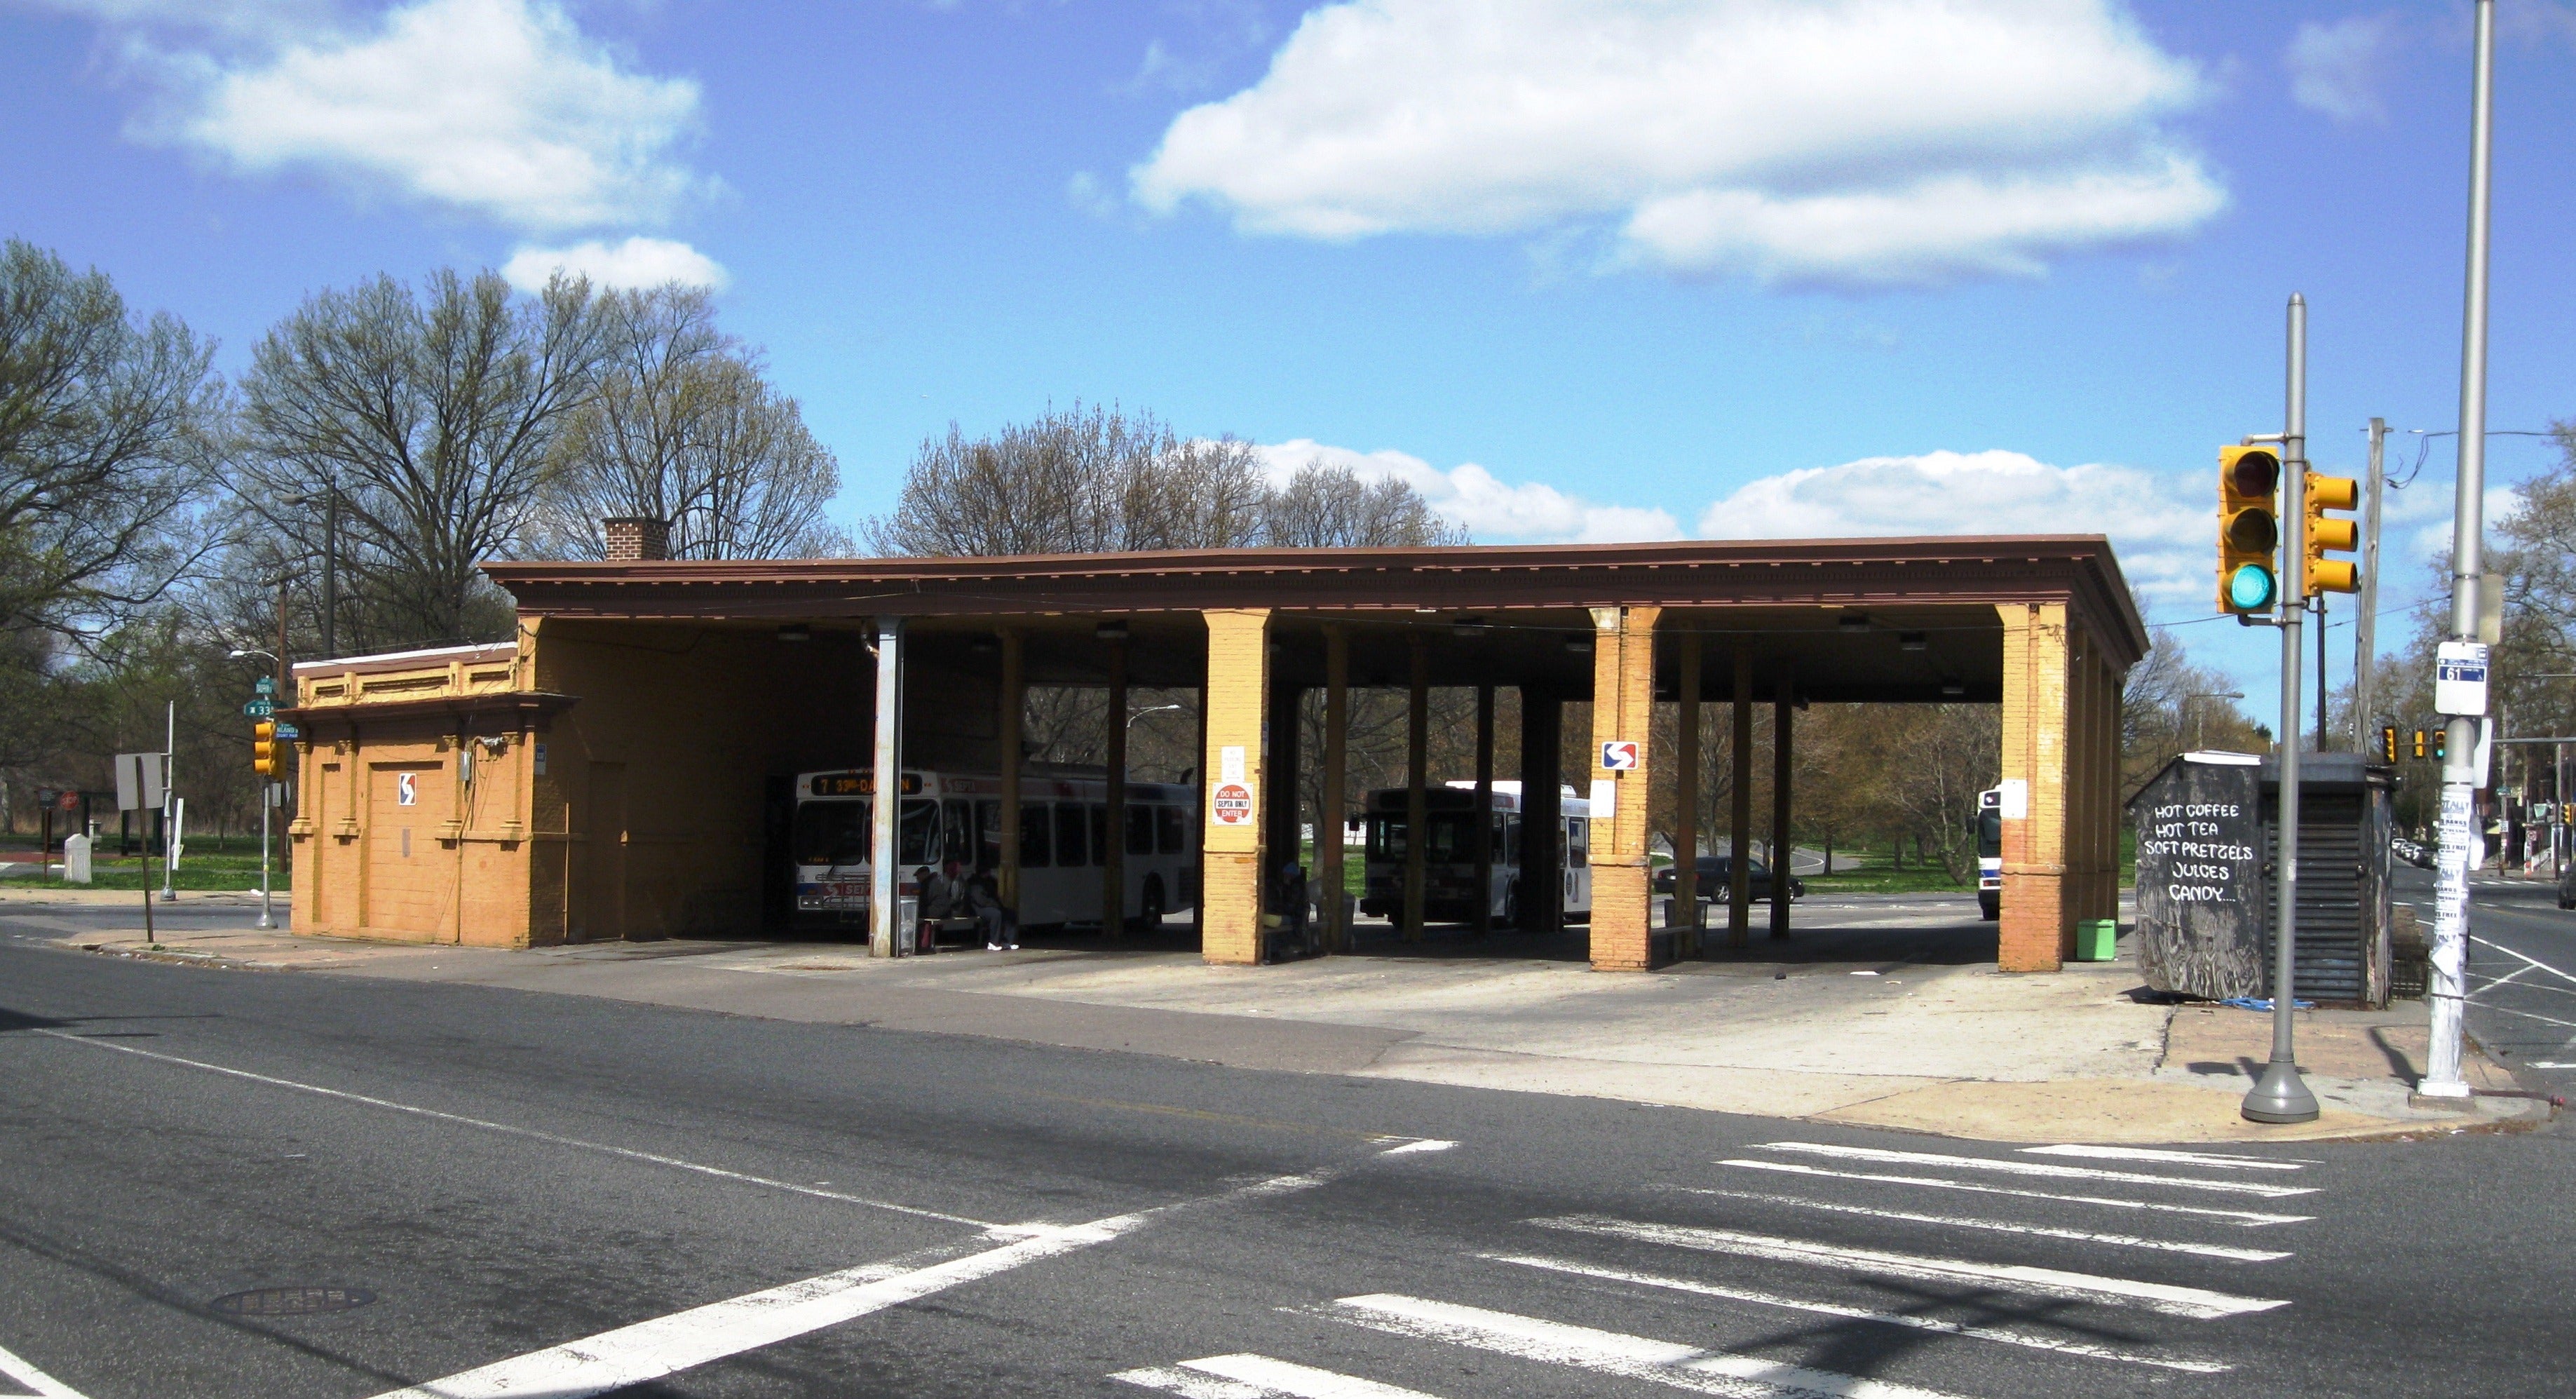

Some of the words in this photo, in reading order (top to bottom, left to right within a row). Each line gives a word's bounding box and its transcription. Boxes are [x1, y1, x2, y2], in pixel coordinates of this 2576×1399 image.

[2446, 667, 2460, 681] 61
[820, 778, 829, 793] 7
[2155, 804, 2183, 818] HOT
[2186, 804, 2239, 818] COFFEE
[2155, 822, 2185, 838] HOT
[2188, 821, 2218, 836] TEA
[2144, 840, 2180, 855] SOFT
[2181, 841, 2253, 860] PRETZELS
[2172, 861, 2230, 880] JUICES
